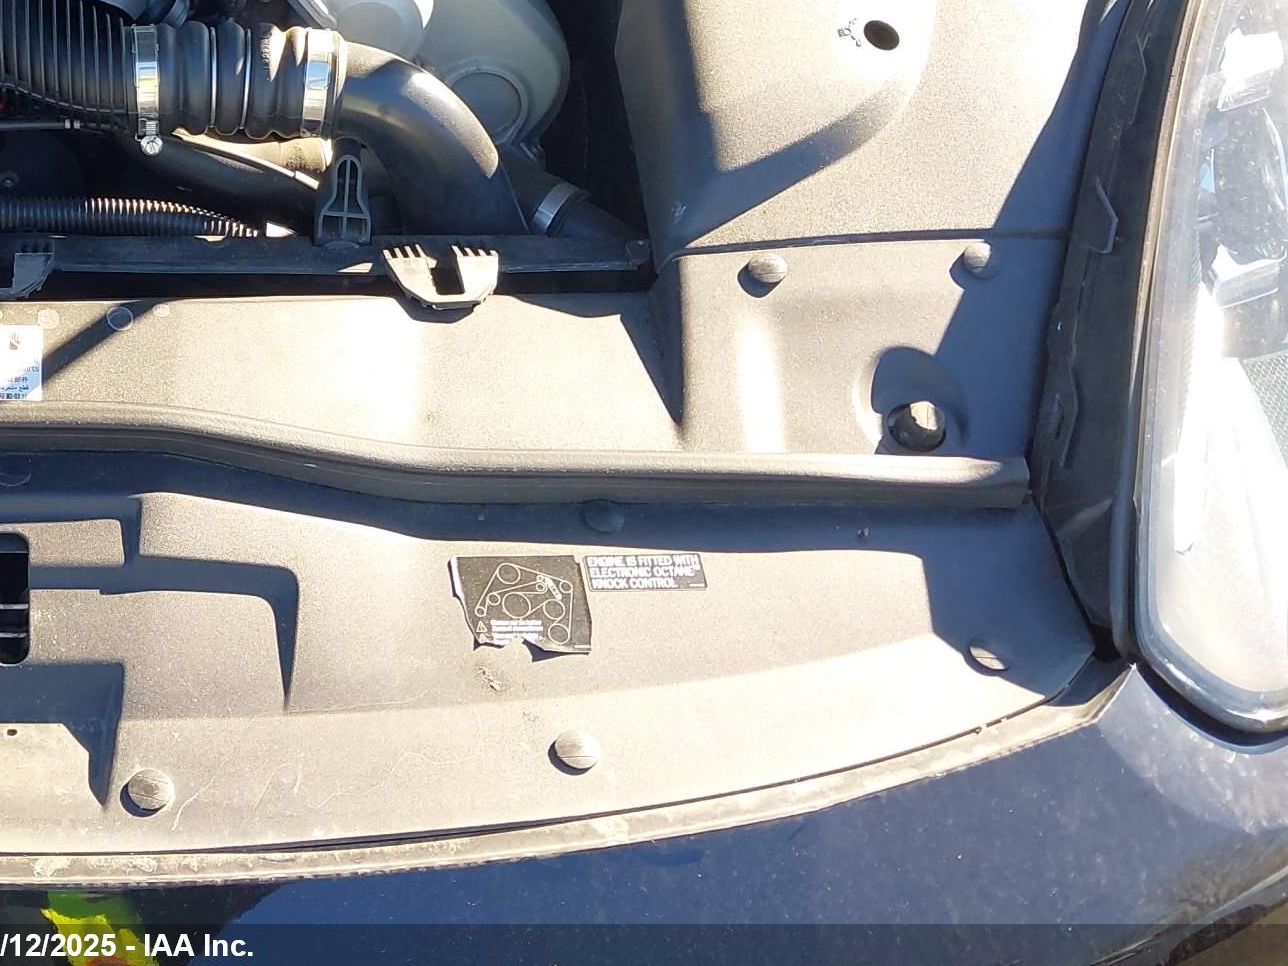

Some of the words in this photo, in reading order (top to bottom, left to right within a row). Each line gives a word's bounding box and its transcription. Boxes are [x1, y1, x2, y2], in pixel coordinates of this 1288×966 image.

[637, 556, 673, 567] FITTED
[672, 554, 700, 566] WITH
[589, 566, 652, 578] ELECTRONIC
[592, 578, 629, 589] KNOCK
[629, 577, 679, 588] CONTROL
